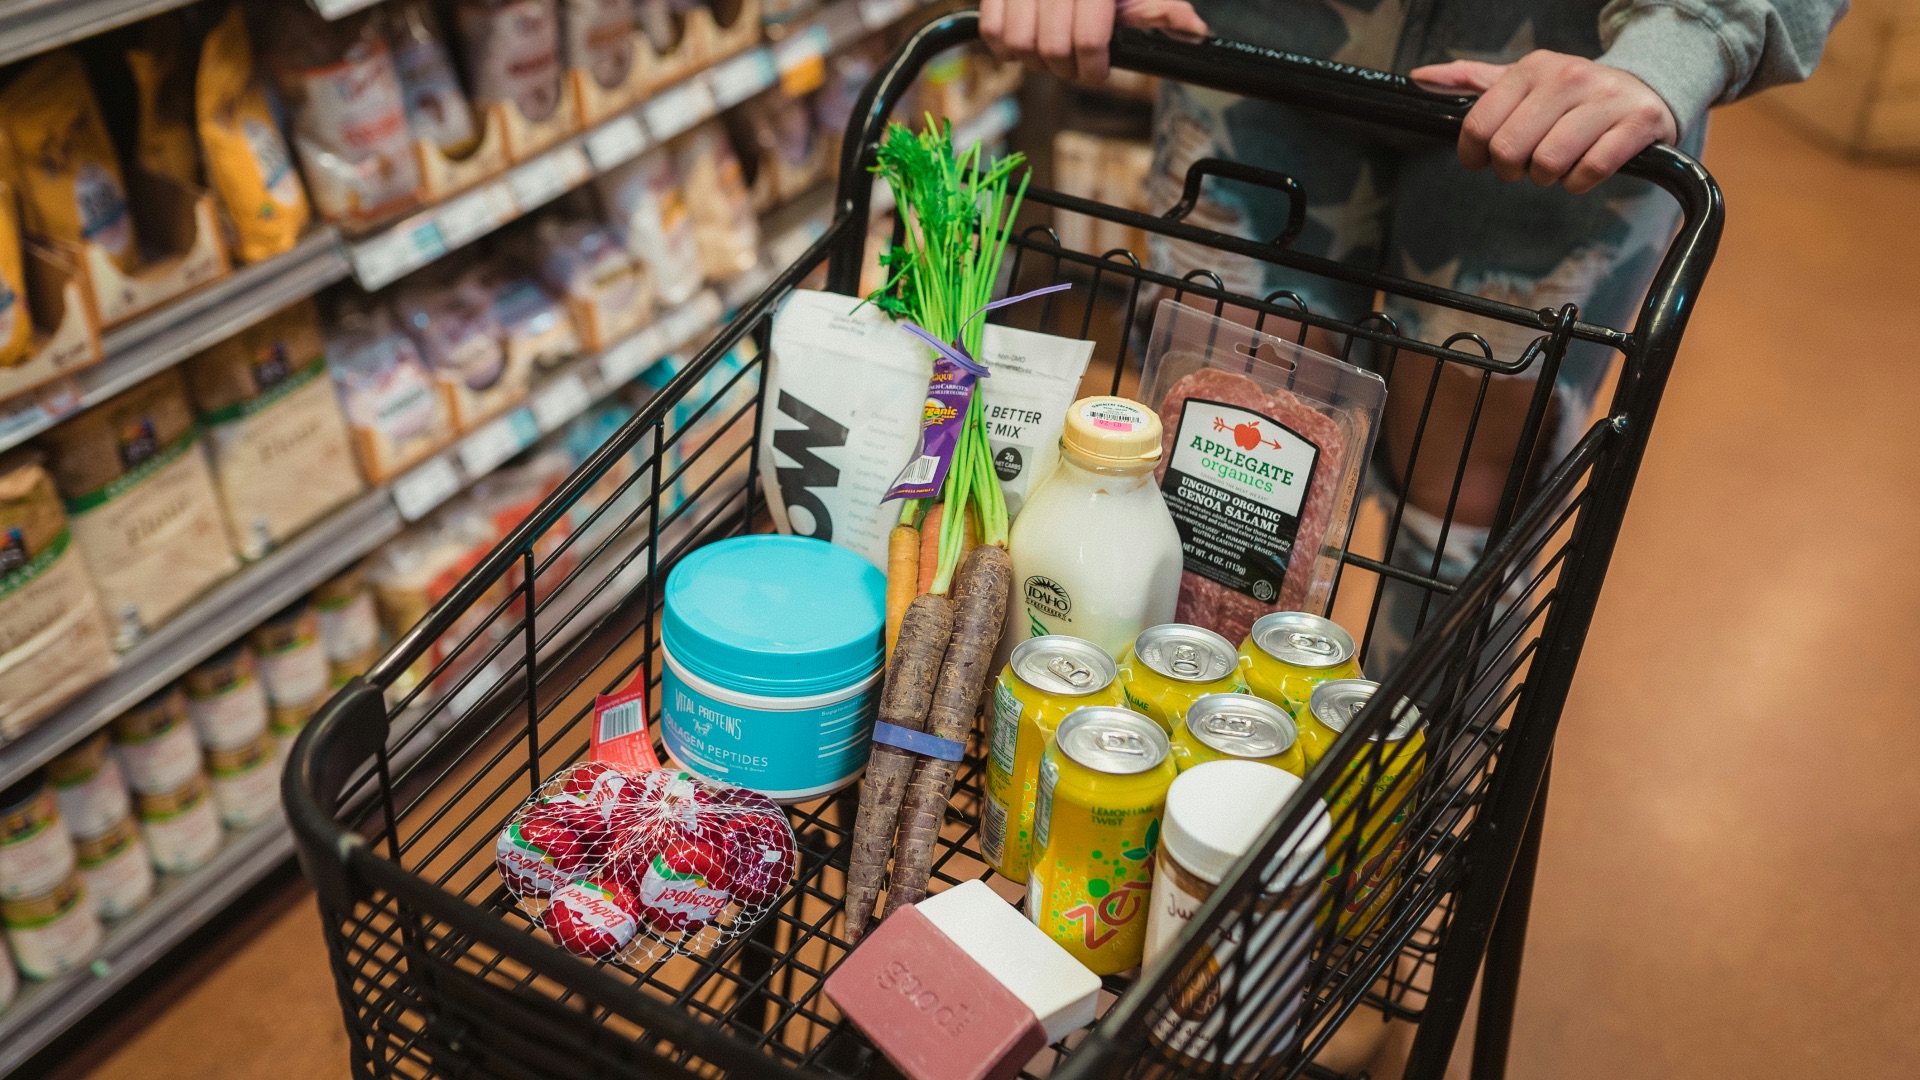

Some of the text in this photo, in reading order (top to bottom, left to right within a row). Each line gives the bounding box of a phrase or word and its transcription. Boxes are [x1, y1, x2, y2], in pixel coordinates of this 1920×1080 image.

[924, 406, 957, 417] rganic
[991, 406, 1042, 424] BETTER
[994, 423, 1022, 439] MIX
[1004, 452, 1014, 462] 2g
[1004, 461, 1021, 471] CARBS
[1190, 435, 1294, 486] APPLEGATE
[1201, 457, 1273, 493] organics
[1177, 486, 1279, 534] GENOA SALAMI
[1182, 476, 1281, 522] UNCURED ORGANIC
[1175, 512, 1206, 530] ANTIBIOTICS
[1225, 533, 1254, 549] HUMANELY
[1192, 504, 1211, 516] nitrates
[1212, 512, 1228, 523] added
[1227, 517, 1244, 529] except
[1244, 523, 1254, 533] for
[1253, 528, 1268, 539] those
[1267, 534, 1291, 548] naturally
[1192, 526, 1212, 539] GLUTEN
[1215, 535, 1233, 549] CASEIN
[1233, 542, 1247, 553] FREE
[1217, 520, 1239, 534] cultured
[1238, 528, 1255, 542] celery
[1254, 534, 1267, 545] juice
[1267, 539, 1288, 553] powder.
[1183, 542, 1196, 554] NET
[1195, 547, 1207, 560] WT.
[1213, 556, 1224, 567] OZ.
[1225, 560, 1247, 576] (113g)
[1192, 536, 1241, 560] KEEP REFRIGERATED
[1028, 585, 1068, 611] IDAHO
[675, 688, 695, 715] VITAL
[698, 705, 742, 740] PROTEINS
[1130, 696, 1150, 712] LIME
[663, 708, 705, 750] COLLAGEN
[708, 744, 768, 767] PEPTIDES
[1091, 804, 1154, 818] LEMON LIME
[1091, 814, 1125, 826] TWIST
[558, 887, 627, 929] Babybel
[655, 886, 728, 916] Babybel
